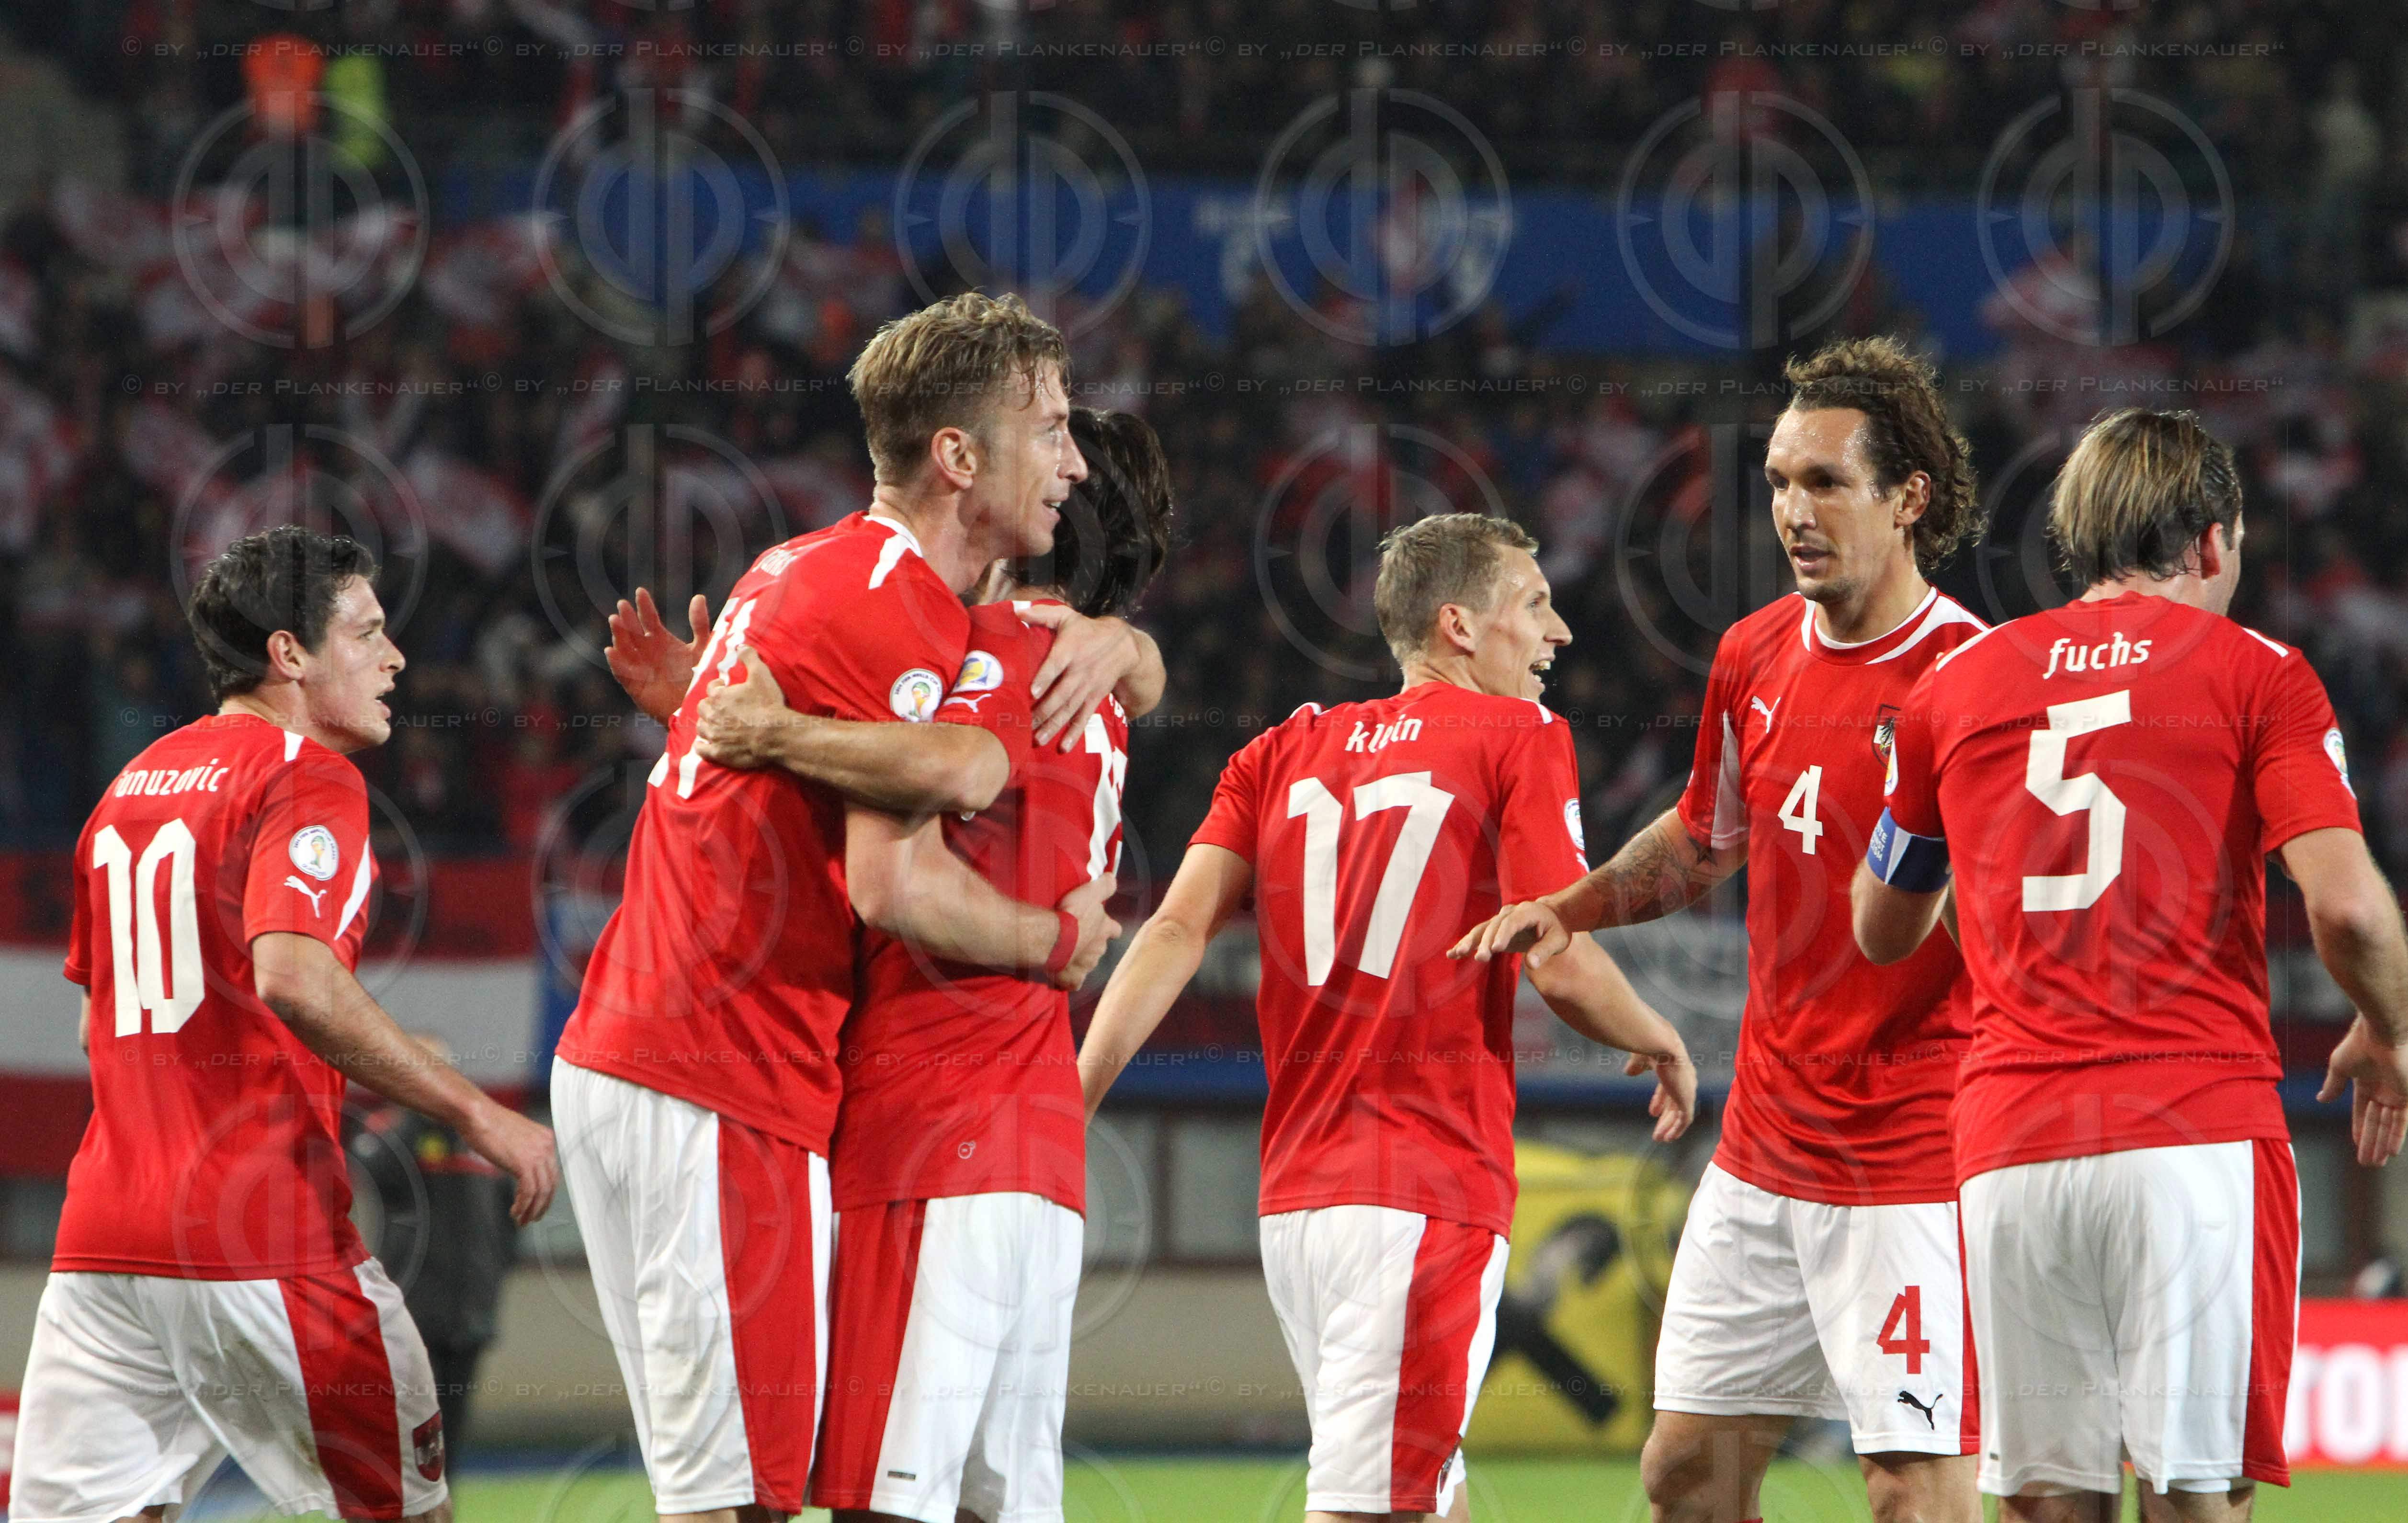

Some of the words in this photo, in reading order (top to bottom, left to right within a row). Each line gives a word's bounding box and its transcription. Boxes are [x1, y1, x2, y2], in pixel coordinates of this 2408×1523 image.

[2043, 631, 2152, 680] fuchs
[1777, 764, 1823, 854] 4
[2022, 690, 2131, 911] 5
[93, 818, 205, 1037] 10
[1287, 771, 1455, 986] 17
[1876, 1285, 1930, 1374] 4
